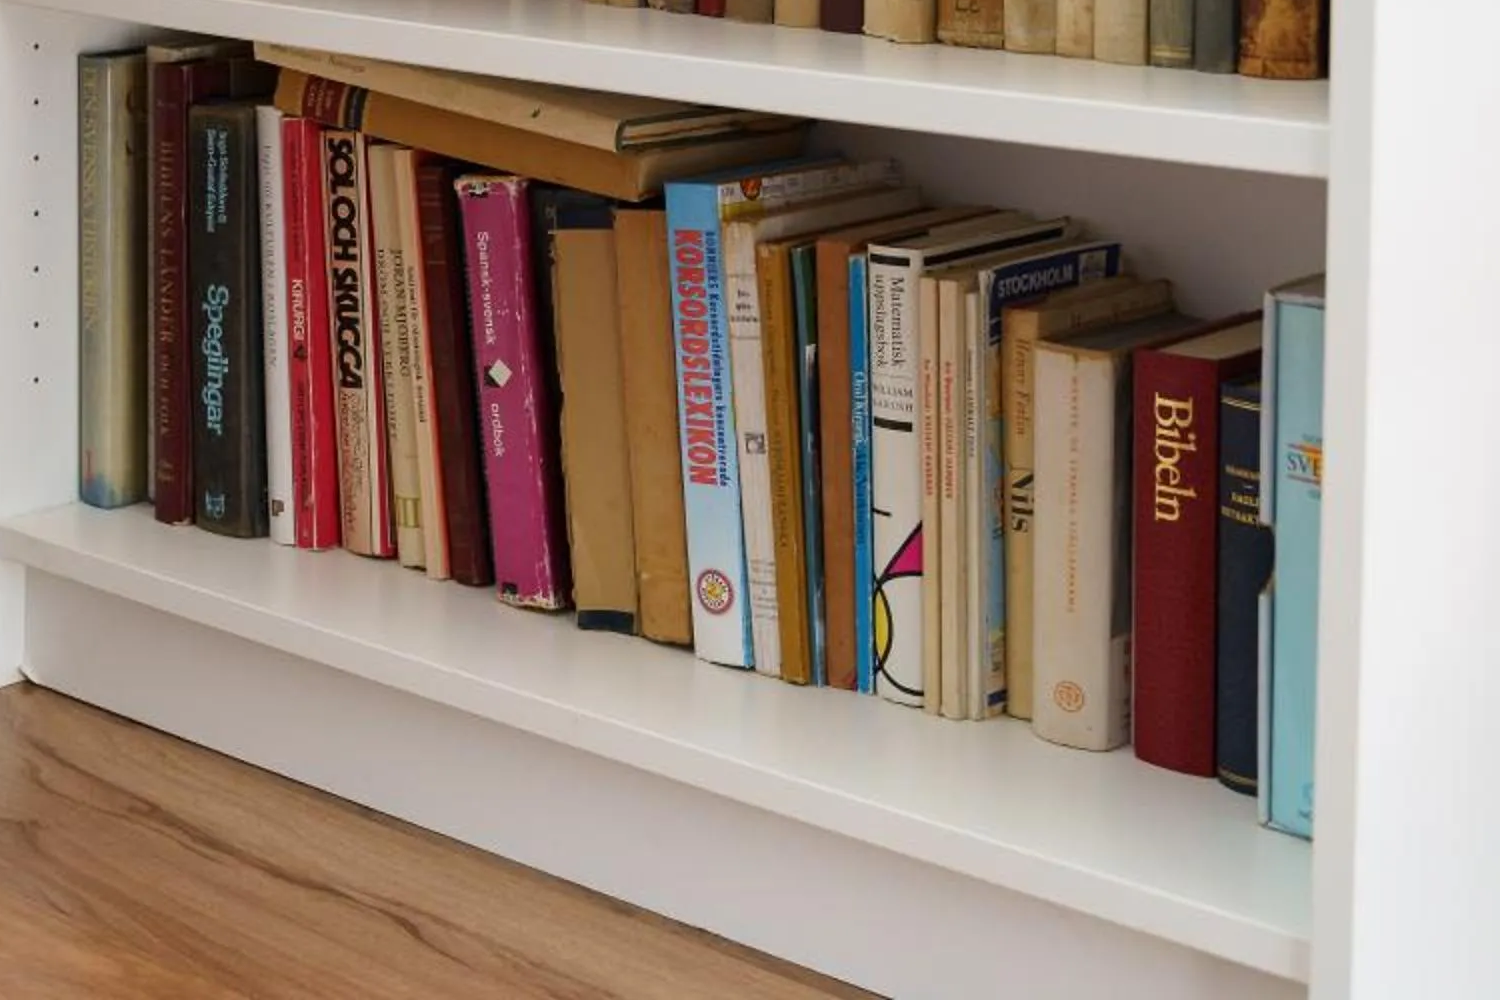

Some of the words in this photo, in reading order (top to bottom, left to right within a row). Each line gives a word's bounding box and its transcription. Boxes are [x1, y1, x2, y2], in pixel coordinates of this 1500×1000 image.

[327, 138, 355, 193] SOL
[331, 195, 358, 261] OCH
[158, 247, 179, 344] LÄNDER
[291, 278, 304, 341] KIRURGI
[333, 265, 362, 390] SKUGGA
[871, 273, 888, 368] uppslagsbok
[888, 276, 905, 367] Matematisk
[1000, 265, 1074, 298] STOCKHOLM
[200, 284, 229, 435] Speglingar
[475, 231, 497, 346] Spansk-svensk
[488, 402, 504, 458] ordbok
[674, 229, 717, 486] KORSORDSLEXIKON
[1010, 467, 1035, 534] Nils
[1153, 392, 1198, 522] Bibeln
[1286, 452, 1322, 478] SVE
